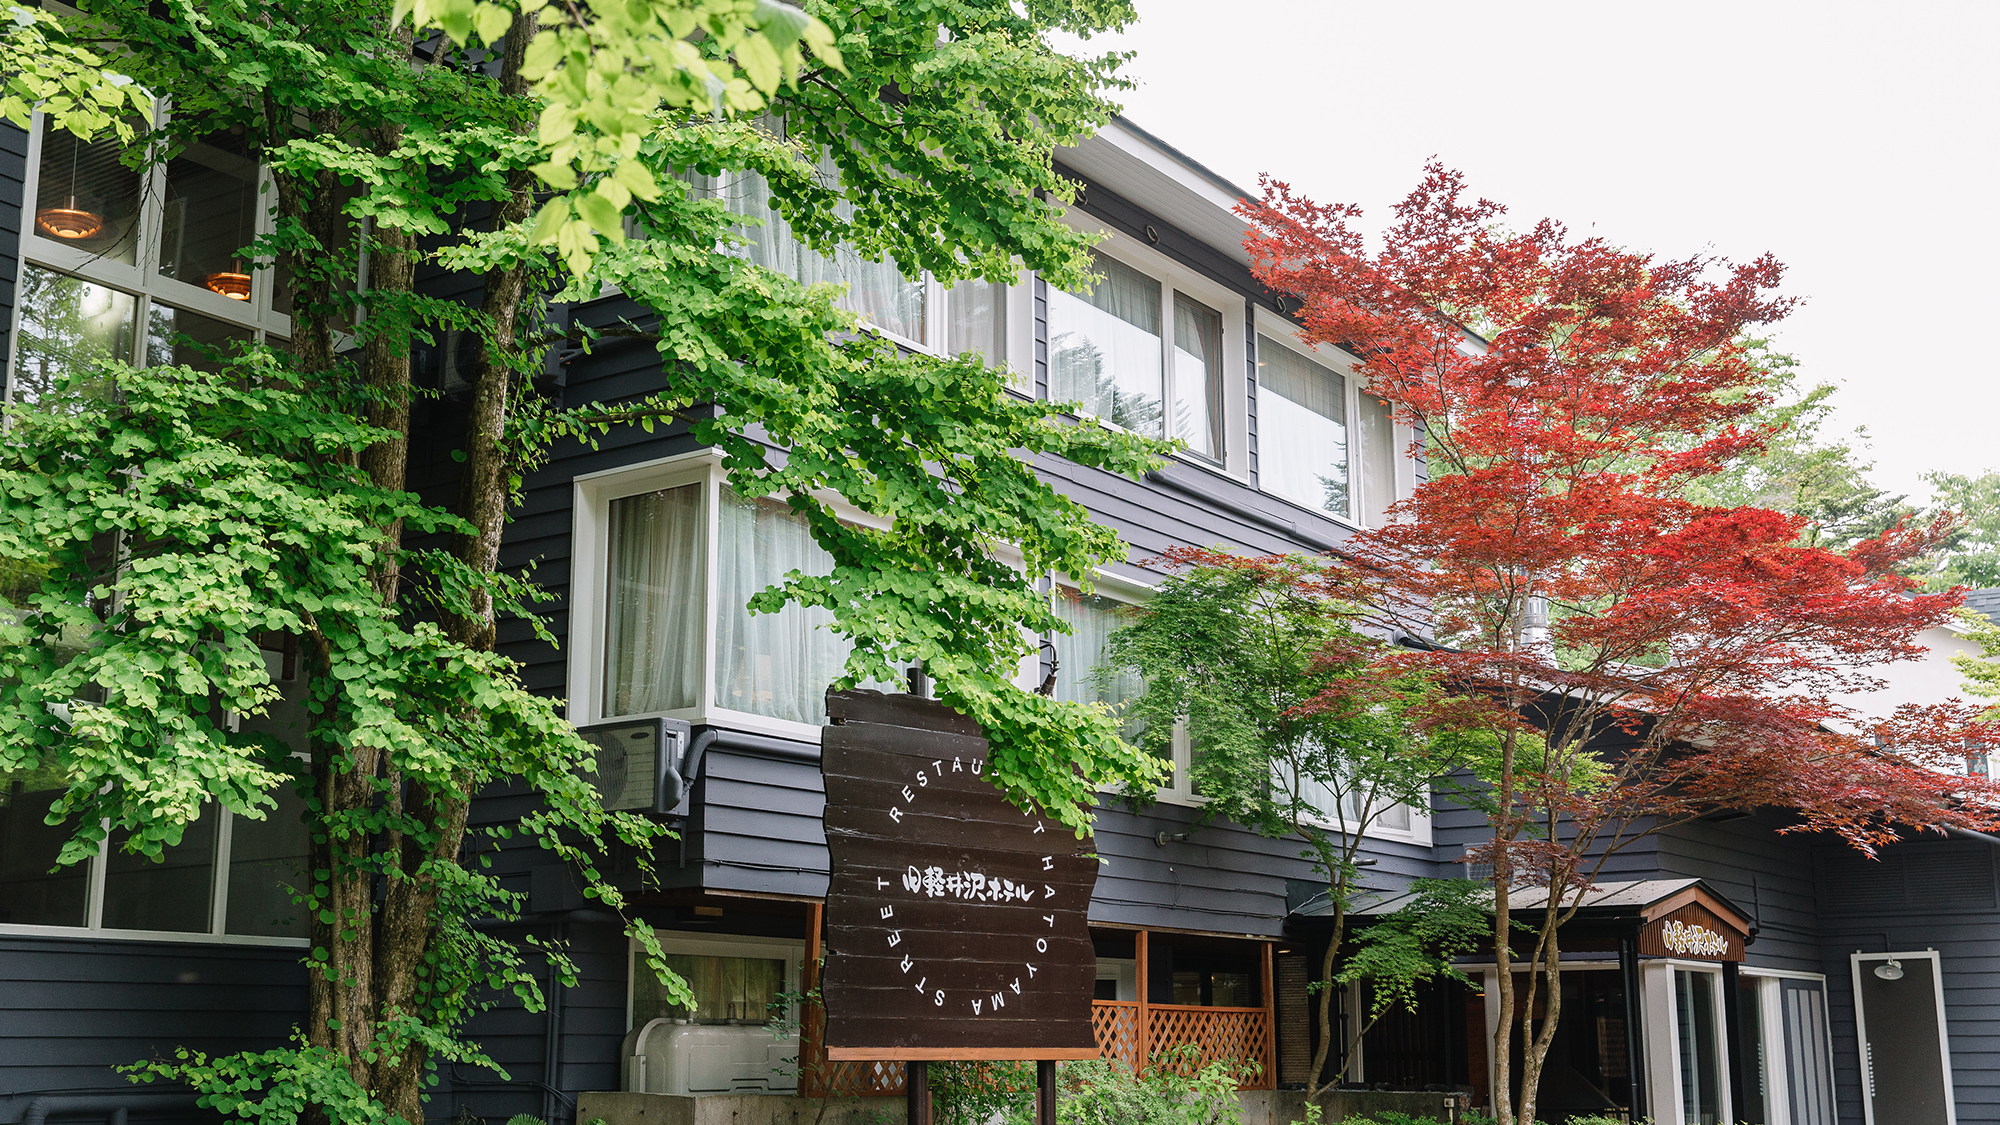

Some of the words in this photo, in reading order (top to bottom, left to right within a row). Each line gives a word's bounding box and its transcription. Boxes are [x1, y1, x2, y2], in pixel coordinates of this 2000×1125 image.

[888, 756, 1045, 834] RESTAUT
[902, 865, 1035, 902] 旧軽井沢ホテル
[971, 856, 1055, 1016] HATOYAMA
[877, 876, 946, 1008] STREET
